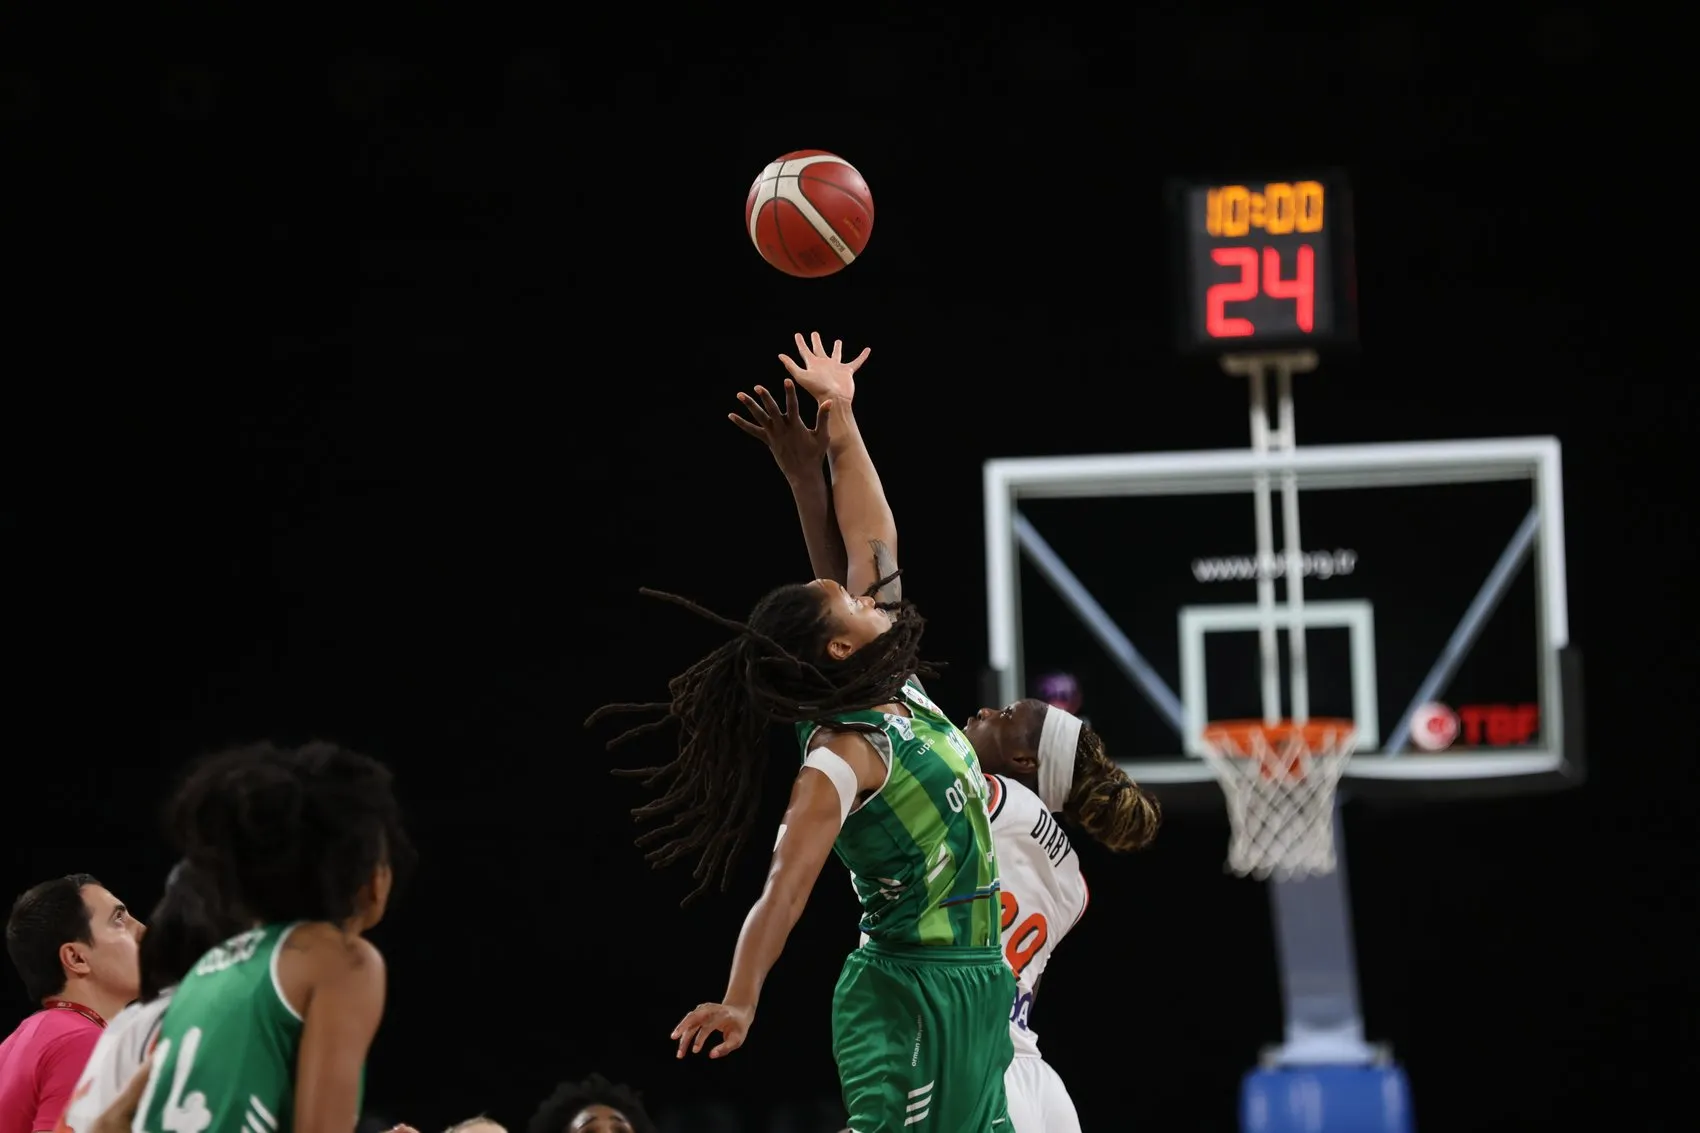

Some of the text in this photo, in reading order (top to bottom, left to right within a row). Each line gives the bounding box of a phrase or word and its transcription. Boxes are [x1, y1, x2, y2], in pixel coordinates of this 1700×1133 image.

[1206, 180, 1324, 237] 10:00
[1206, 244, 1314, 337] 24
[1030, 808, 1071, 868] DIABY
